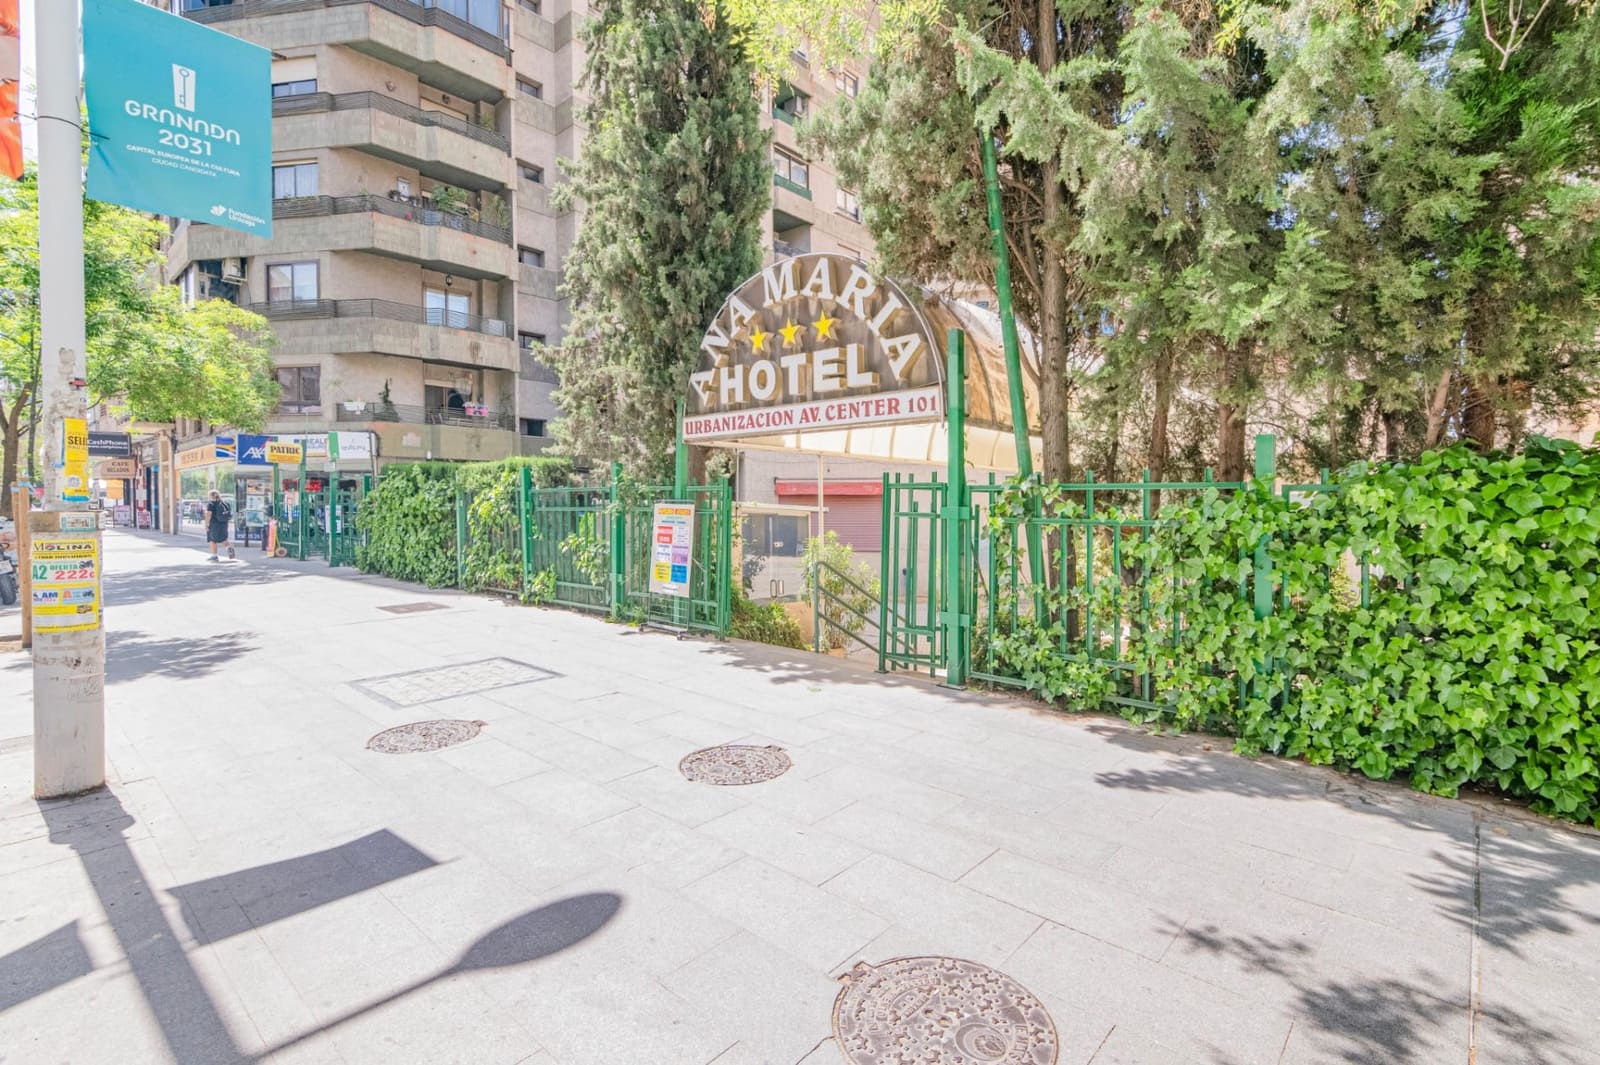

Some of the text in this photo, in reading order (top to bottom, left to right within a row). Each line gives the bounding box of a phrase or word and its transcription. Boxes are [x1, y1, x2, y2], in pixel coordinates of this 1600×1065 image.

[126, 144, 241, 176] CAPITAL EUROPEA DE LA CULTURA
[159, 129, 212, 156] 2031
[761, 256, 923, 381] MARIA
[719, 342, 874, 405] HOTEL
[684, 395, 938, 436] URBANIZACION AV. CENTER 101
[32, 564, 48, 580] A2
